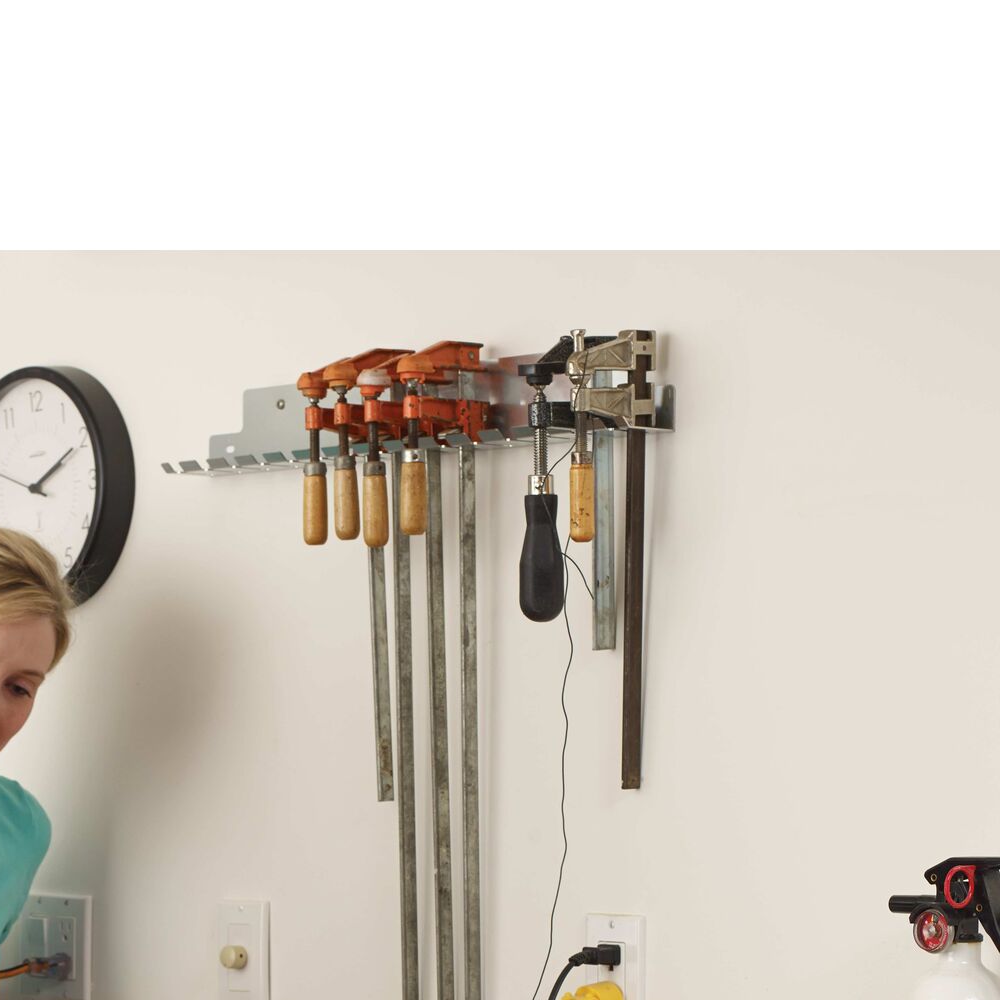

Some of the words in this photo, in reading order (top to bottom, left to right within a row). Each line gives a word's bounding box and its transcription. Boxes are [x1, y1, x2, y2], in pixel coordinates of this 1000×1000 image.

[29, 390, 43, 413] 12
[60, 402, 66, 424] 1
[3, 407, 15, 430] 11
[78, 426, 90, 449] 2
[88, 468, 96, 490] 3
[81, 513, 90, 531] 4
[63, 546, 73, 569] 5
